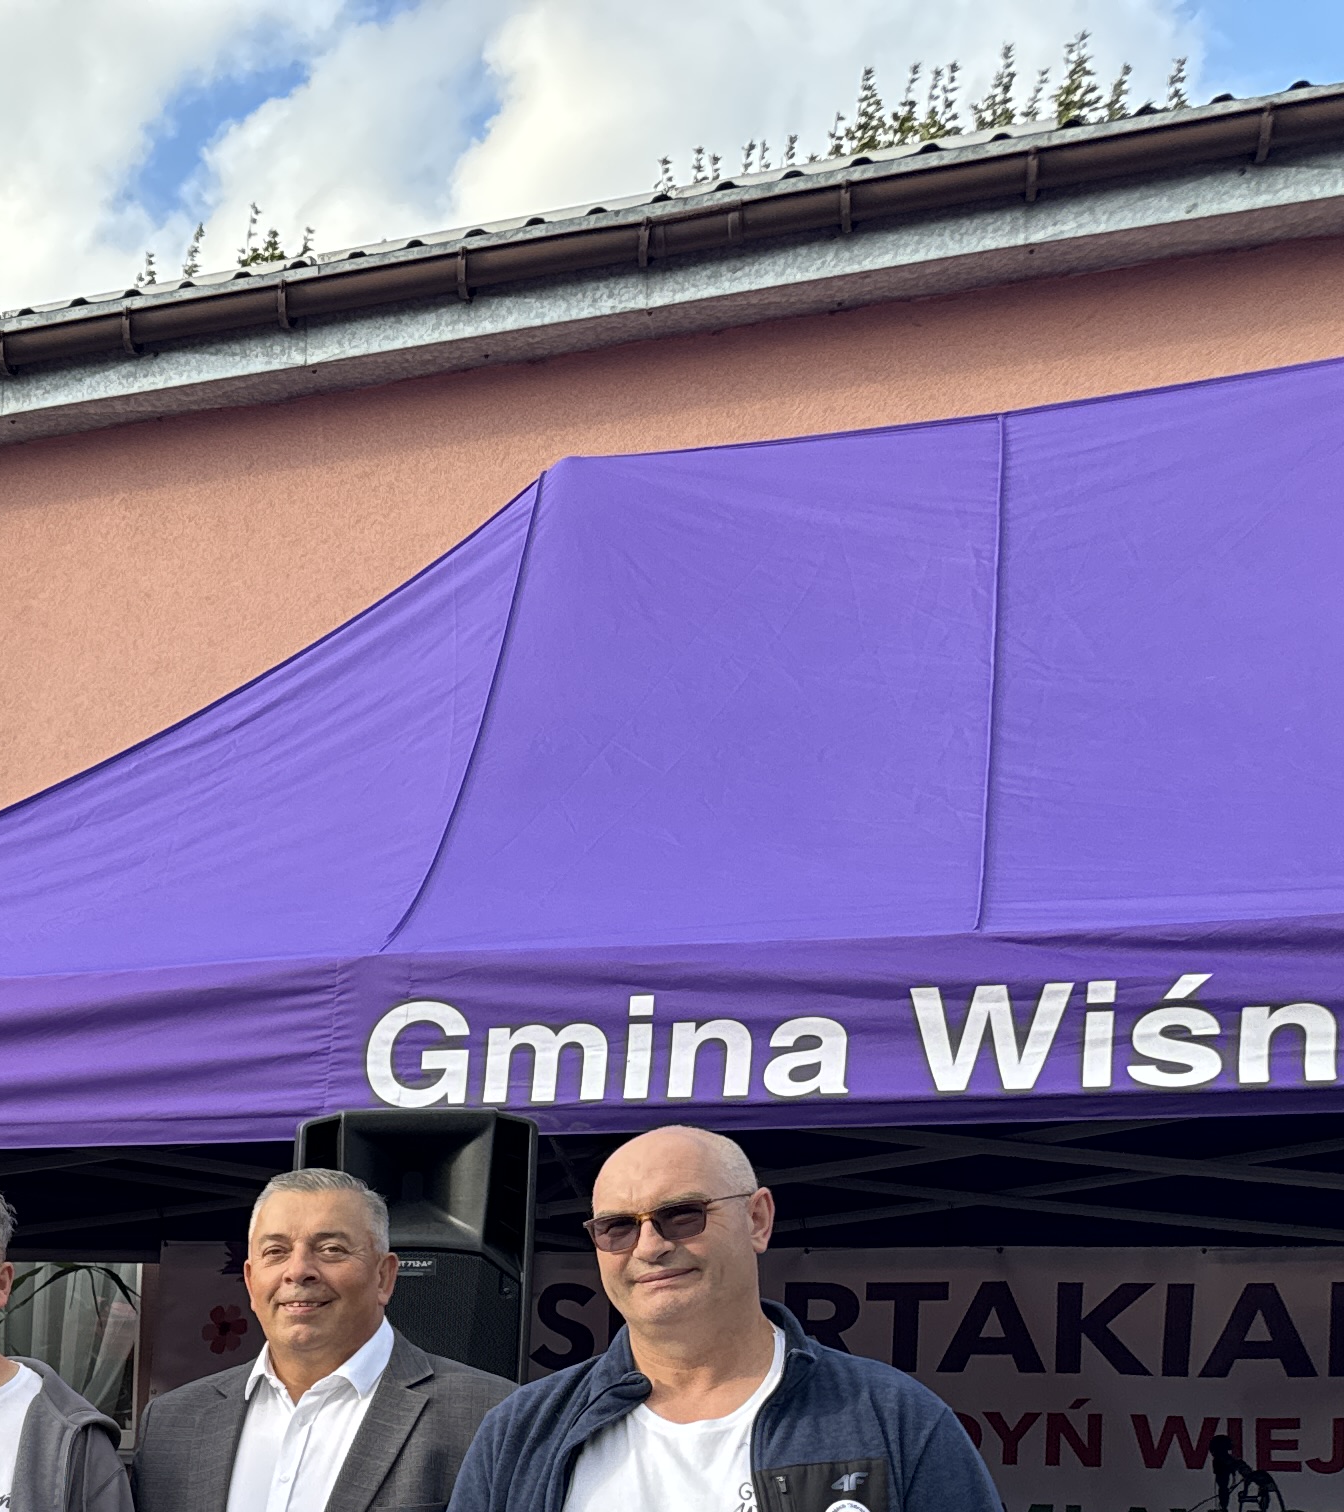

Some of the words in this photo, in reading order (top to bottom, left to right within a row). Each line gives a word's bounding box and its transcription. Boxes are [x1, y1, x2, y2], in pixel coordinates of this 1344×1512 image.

[365, 995, 848, 1108] Gmina
[909, 972, 1339, 1093] Wiśn
[529, 1281, 1344, 1378] SRTAKIA
[831, 1471, 868, 1492] 4F
